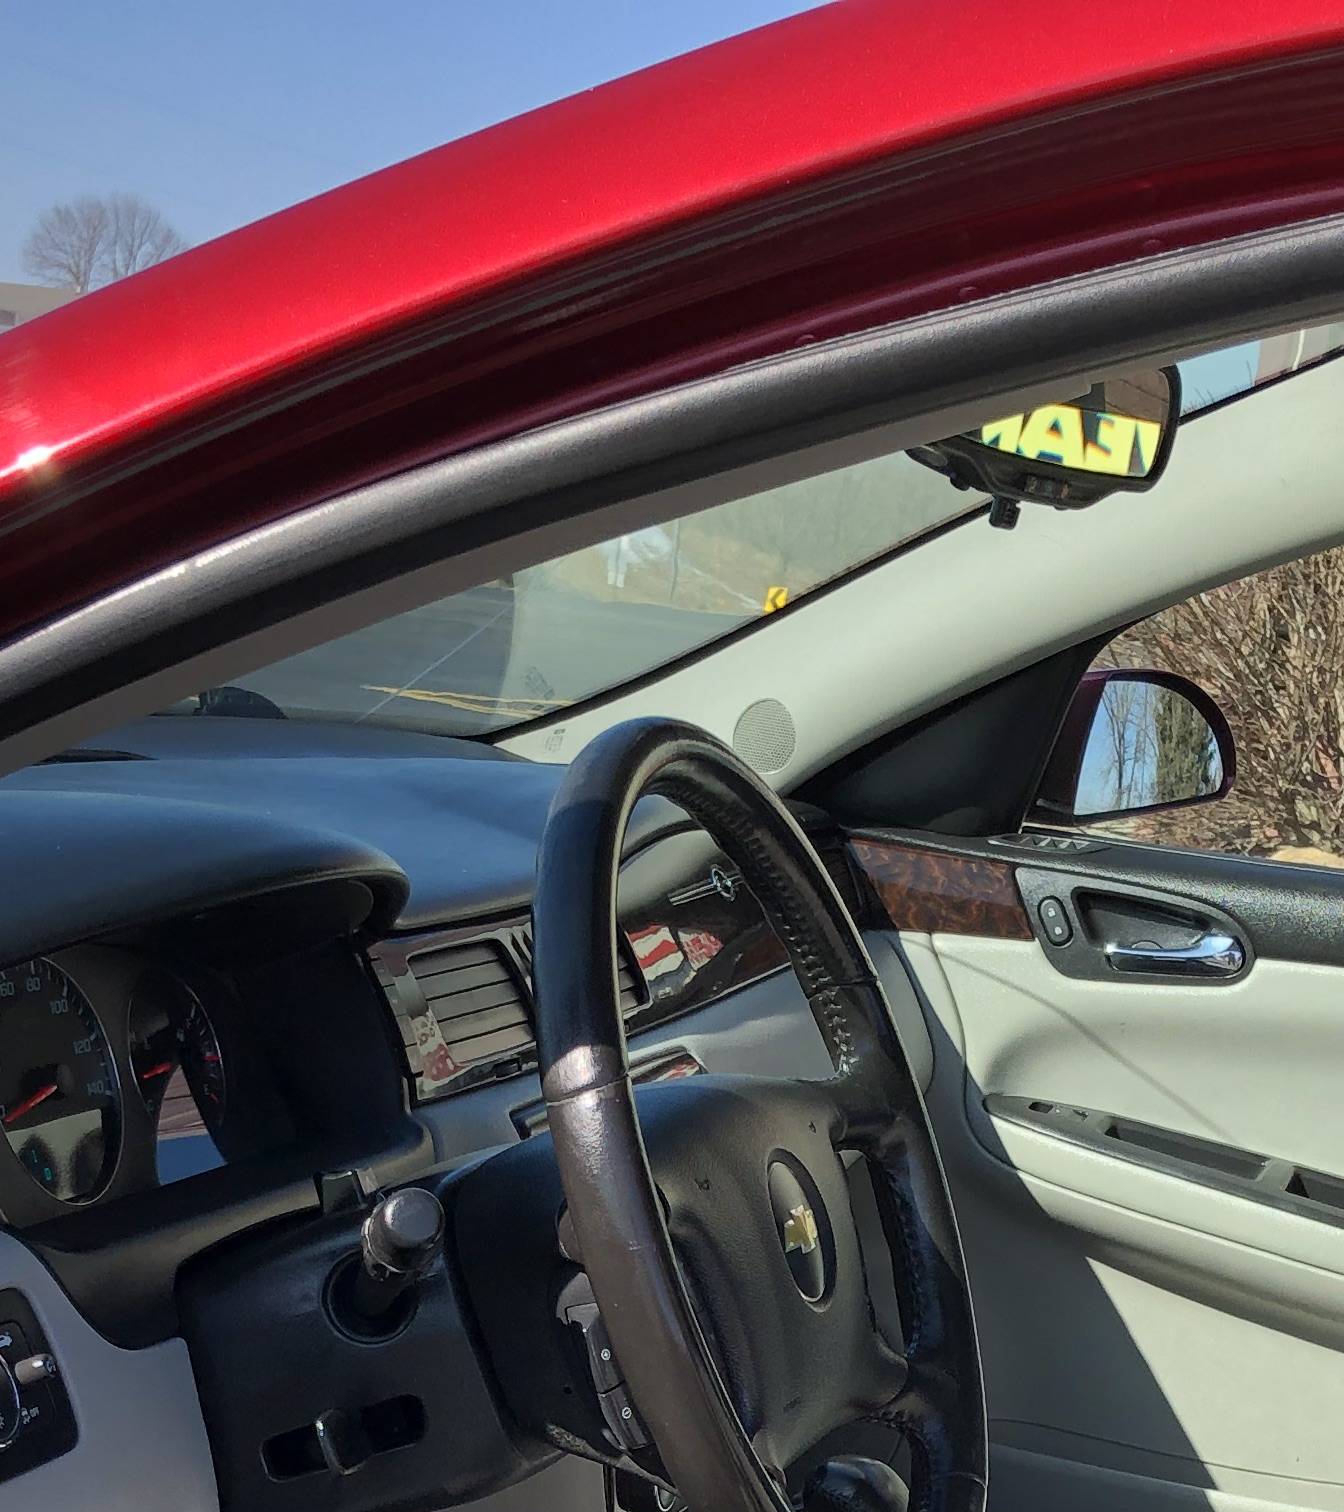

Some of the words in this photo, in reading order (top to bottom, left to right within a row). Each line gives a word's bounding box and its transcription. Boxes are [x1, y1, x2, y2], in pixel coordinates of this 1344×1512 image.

[0, 982, 15, 997] 60
[26, 976, 41, 992] 80
[49, 999, 69, 1015] 100
[73, 1038, 92, 1055] 120
